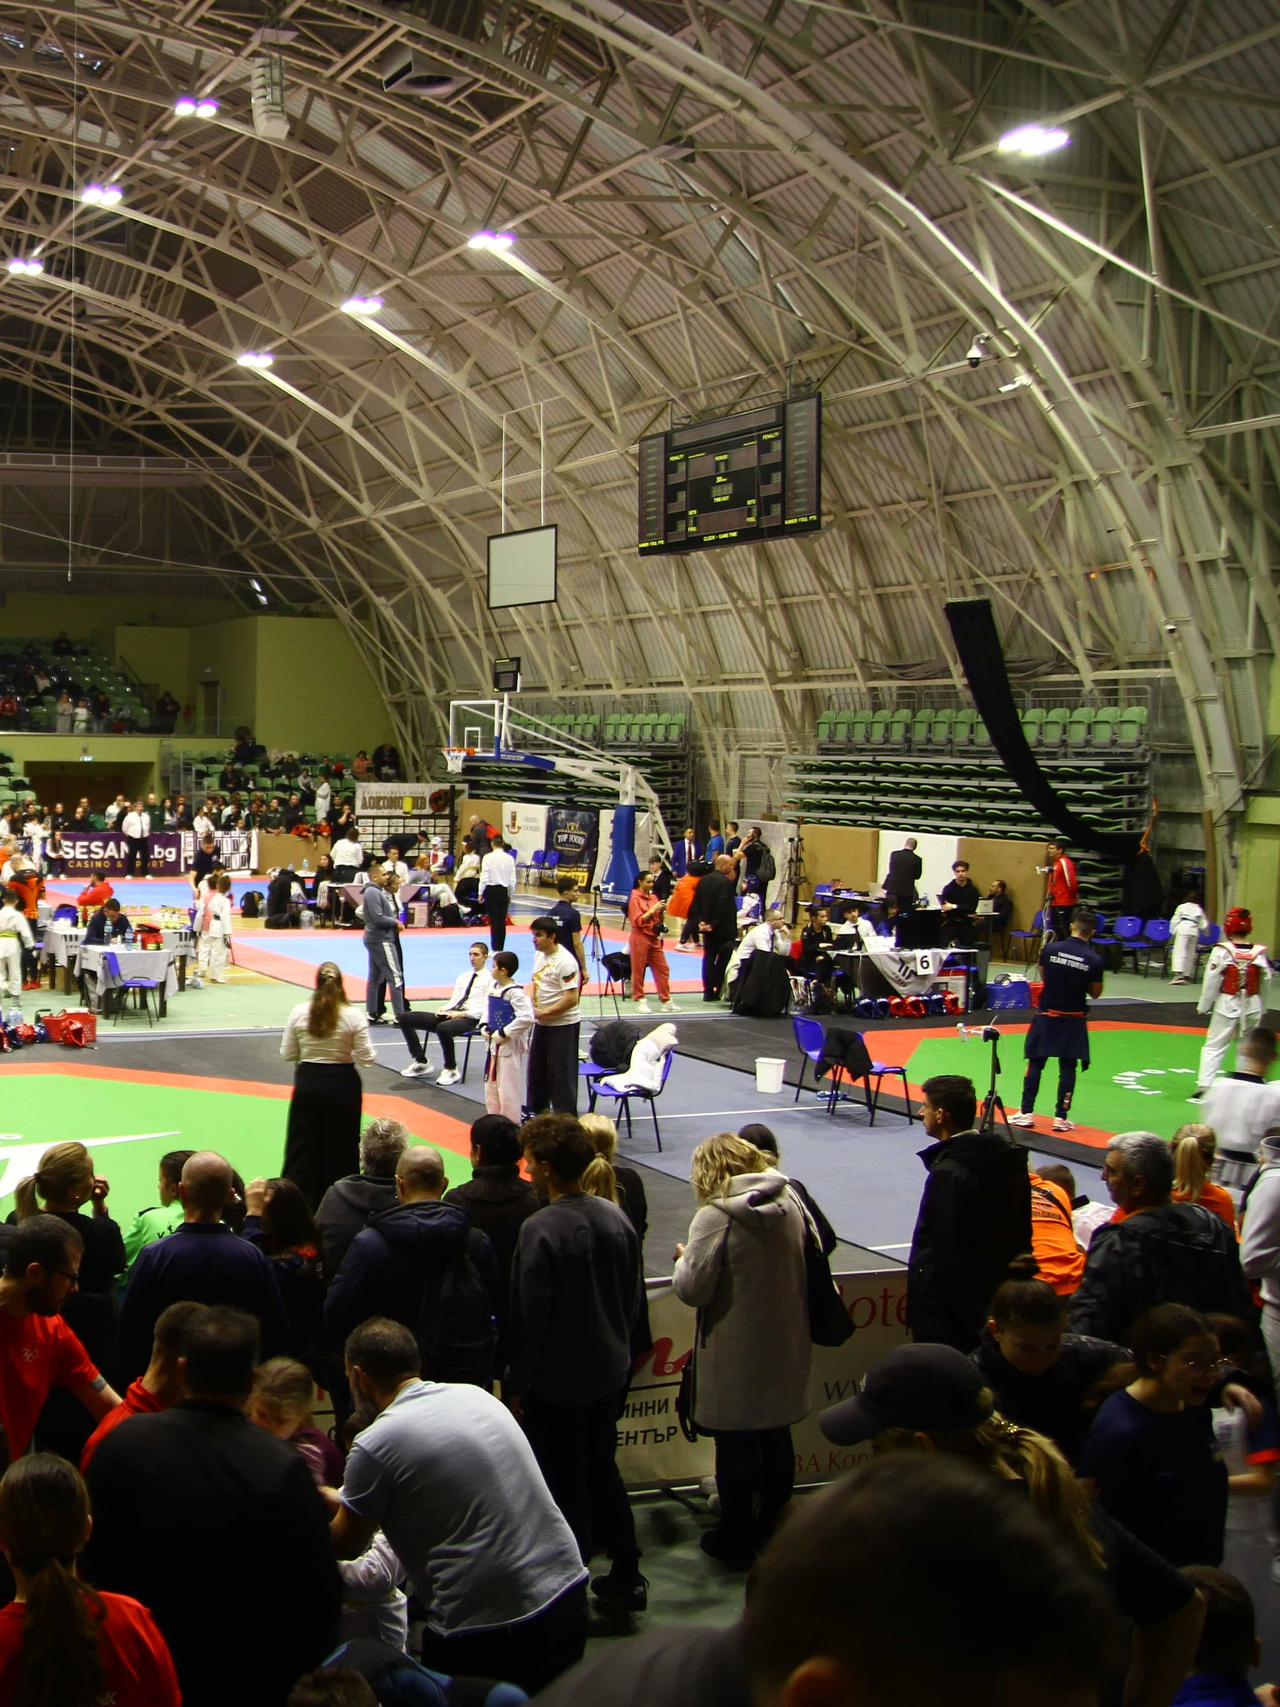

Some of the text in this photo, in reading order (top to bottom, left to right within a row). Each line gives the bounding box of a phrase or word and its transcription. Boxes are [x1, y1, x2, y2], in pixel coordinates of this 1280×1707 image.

[67, 860, 111, 868] CASINO
[116, 860, 123, 868] &
[920, 955, 930, 970] 6
[1049, 955, 1068, 966] TEAM
[616, 1426, 678, 1447] ЕНТЪР
